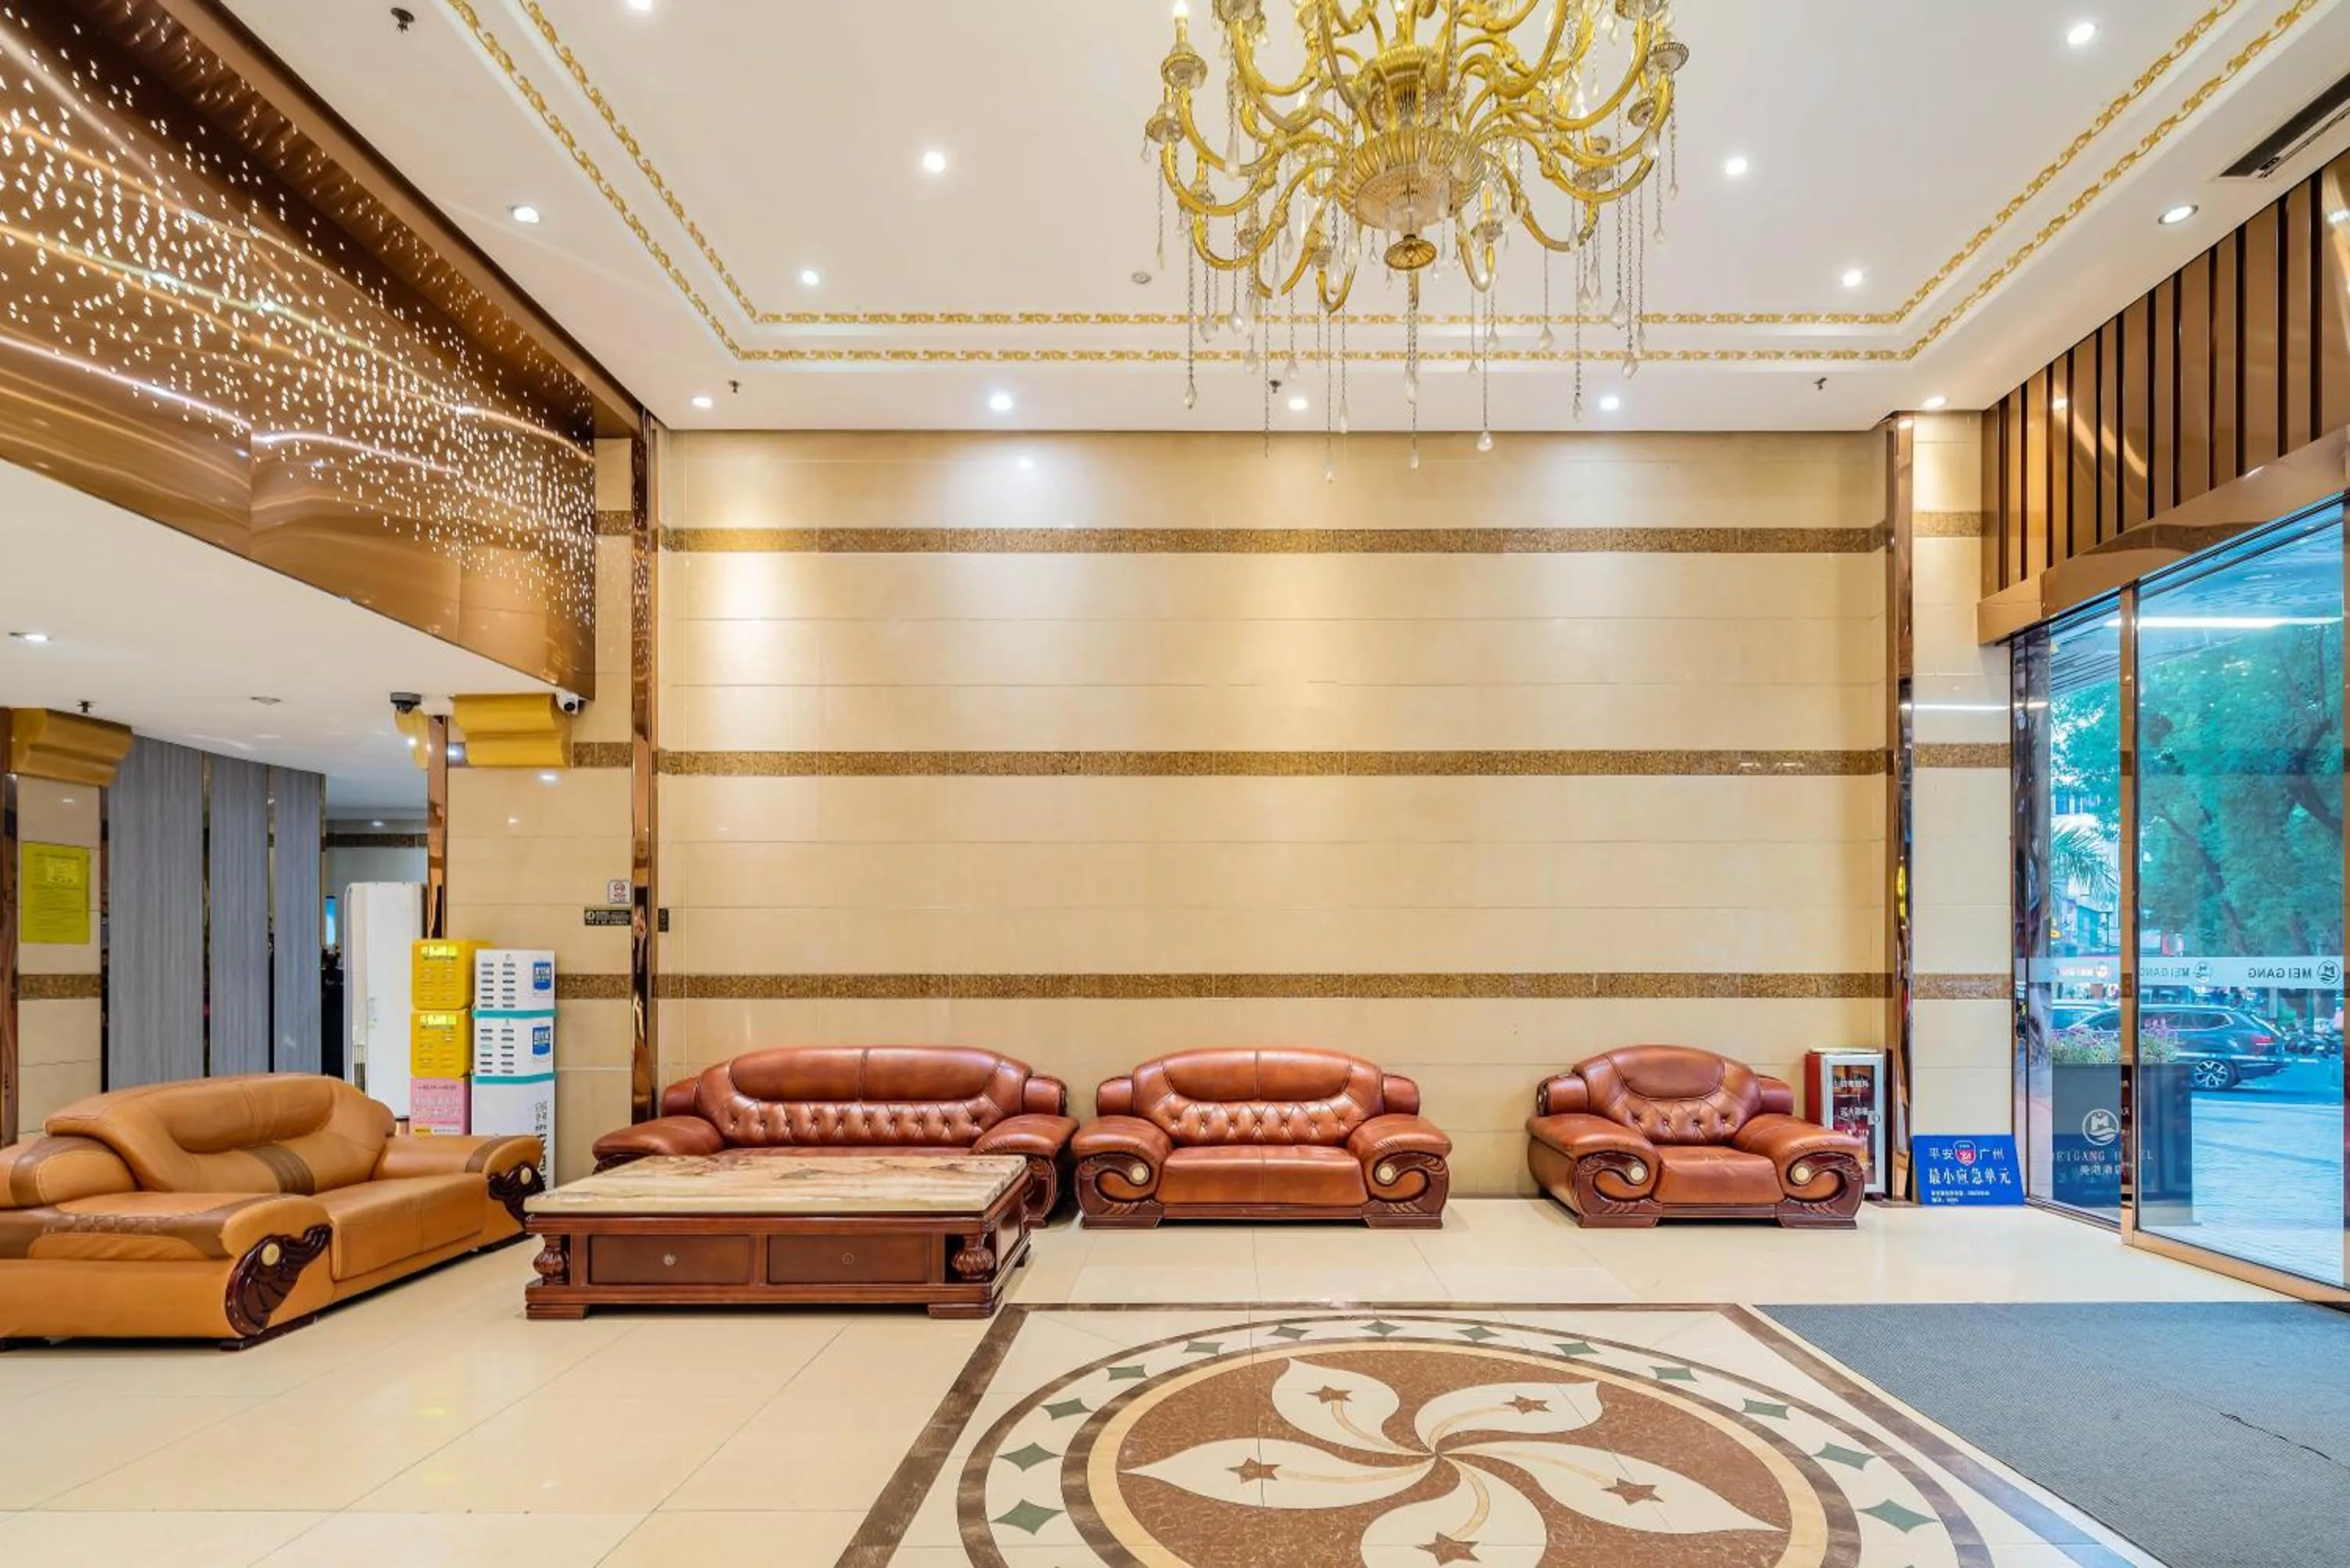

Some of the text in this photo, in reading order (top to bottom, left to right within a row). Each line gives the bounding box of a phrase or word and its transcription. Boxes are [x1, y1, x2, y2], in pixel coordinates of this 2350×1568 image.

[1929, 1147, 2005, 1160] 平安 广州
[1929, 1167, 2012, 1185] 最小应急单元
